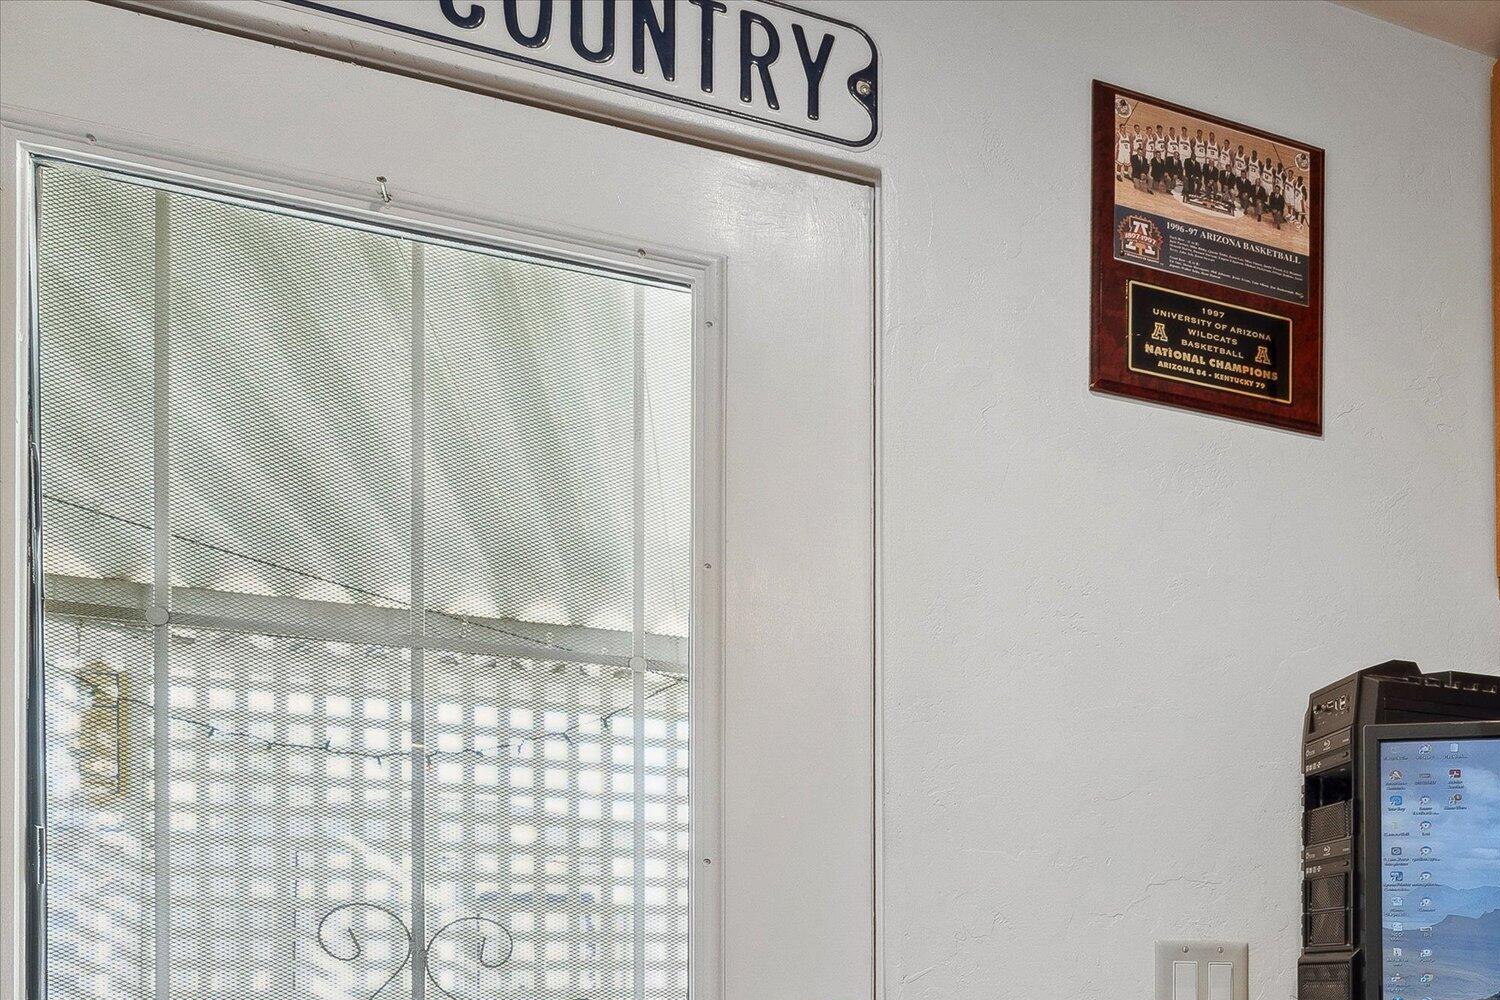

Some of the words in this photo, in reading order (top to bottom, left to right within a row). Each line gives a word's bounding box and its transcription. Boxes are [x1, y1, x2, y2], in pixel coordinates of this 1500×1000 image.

[1166, 221, 1199, 236] 1996-97
[1200, 231, 1241, 250] ARIZONA
[1243, 242, 1301, 264] BASKETBALL
[1152, 308, 1212, 328] UNIVERSITY
[1214, 322, 1227, 331] OF
[1230, 326, 1272, 342] ARIZONA
[1201, 308, 1225, 318] 1997
[1181, 339, 1244, 359] BASKETBALL
[1187, 328, 1238, 346] WILDCATS
[1144, 343, 1206, 366] NATIONAL
[1208, 357, 1278, 381] CHAMPIONS
[1157, 360, 1195, 375] ARIZONA
[1196, 368, 1207, 378] 84
[1214, 372, 1254, 387] KENTUCKY
[1255, 380, 1266, 390] 79
